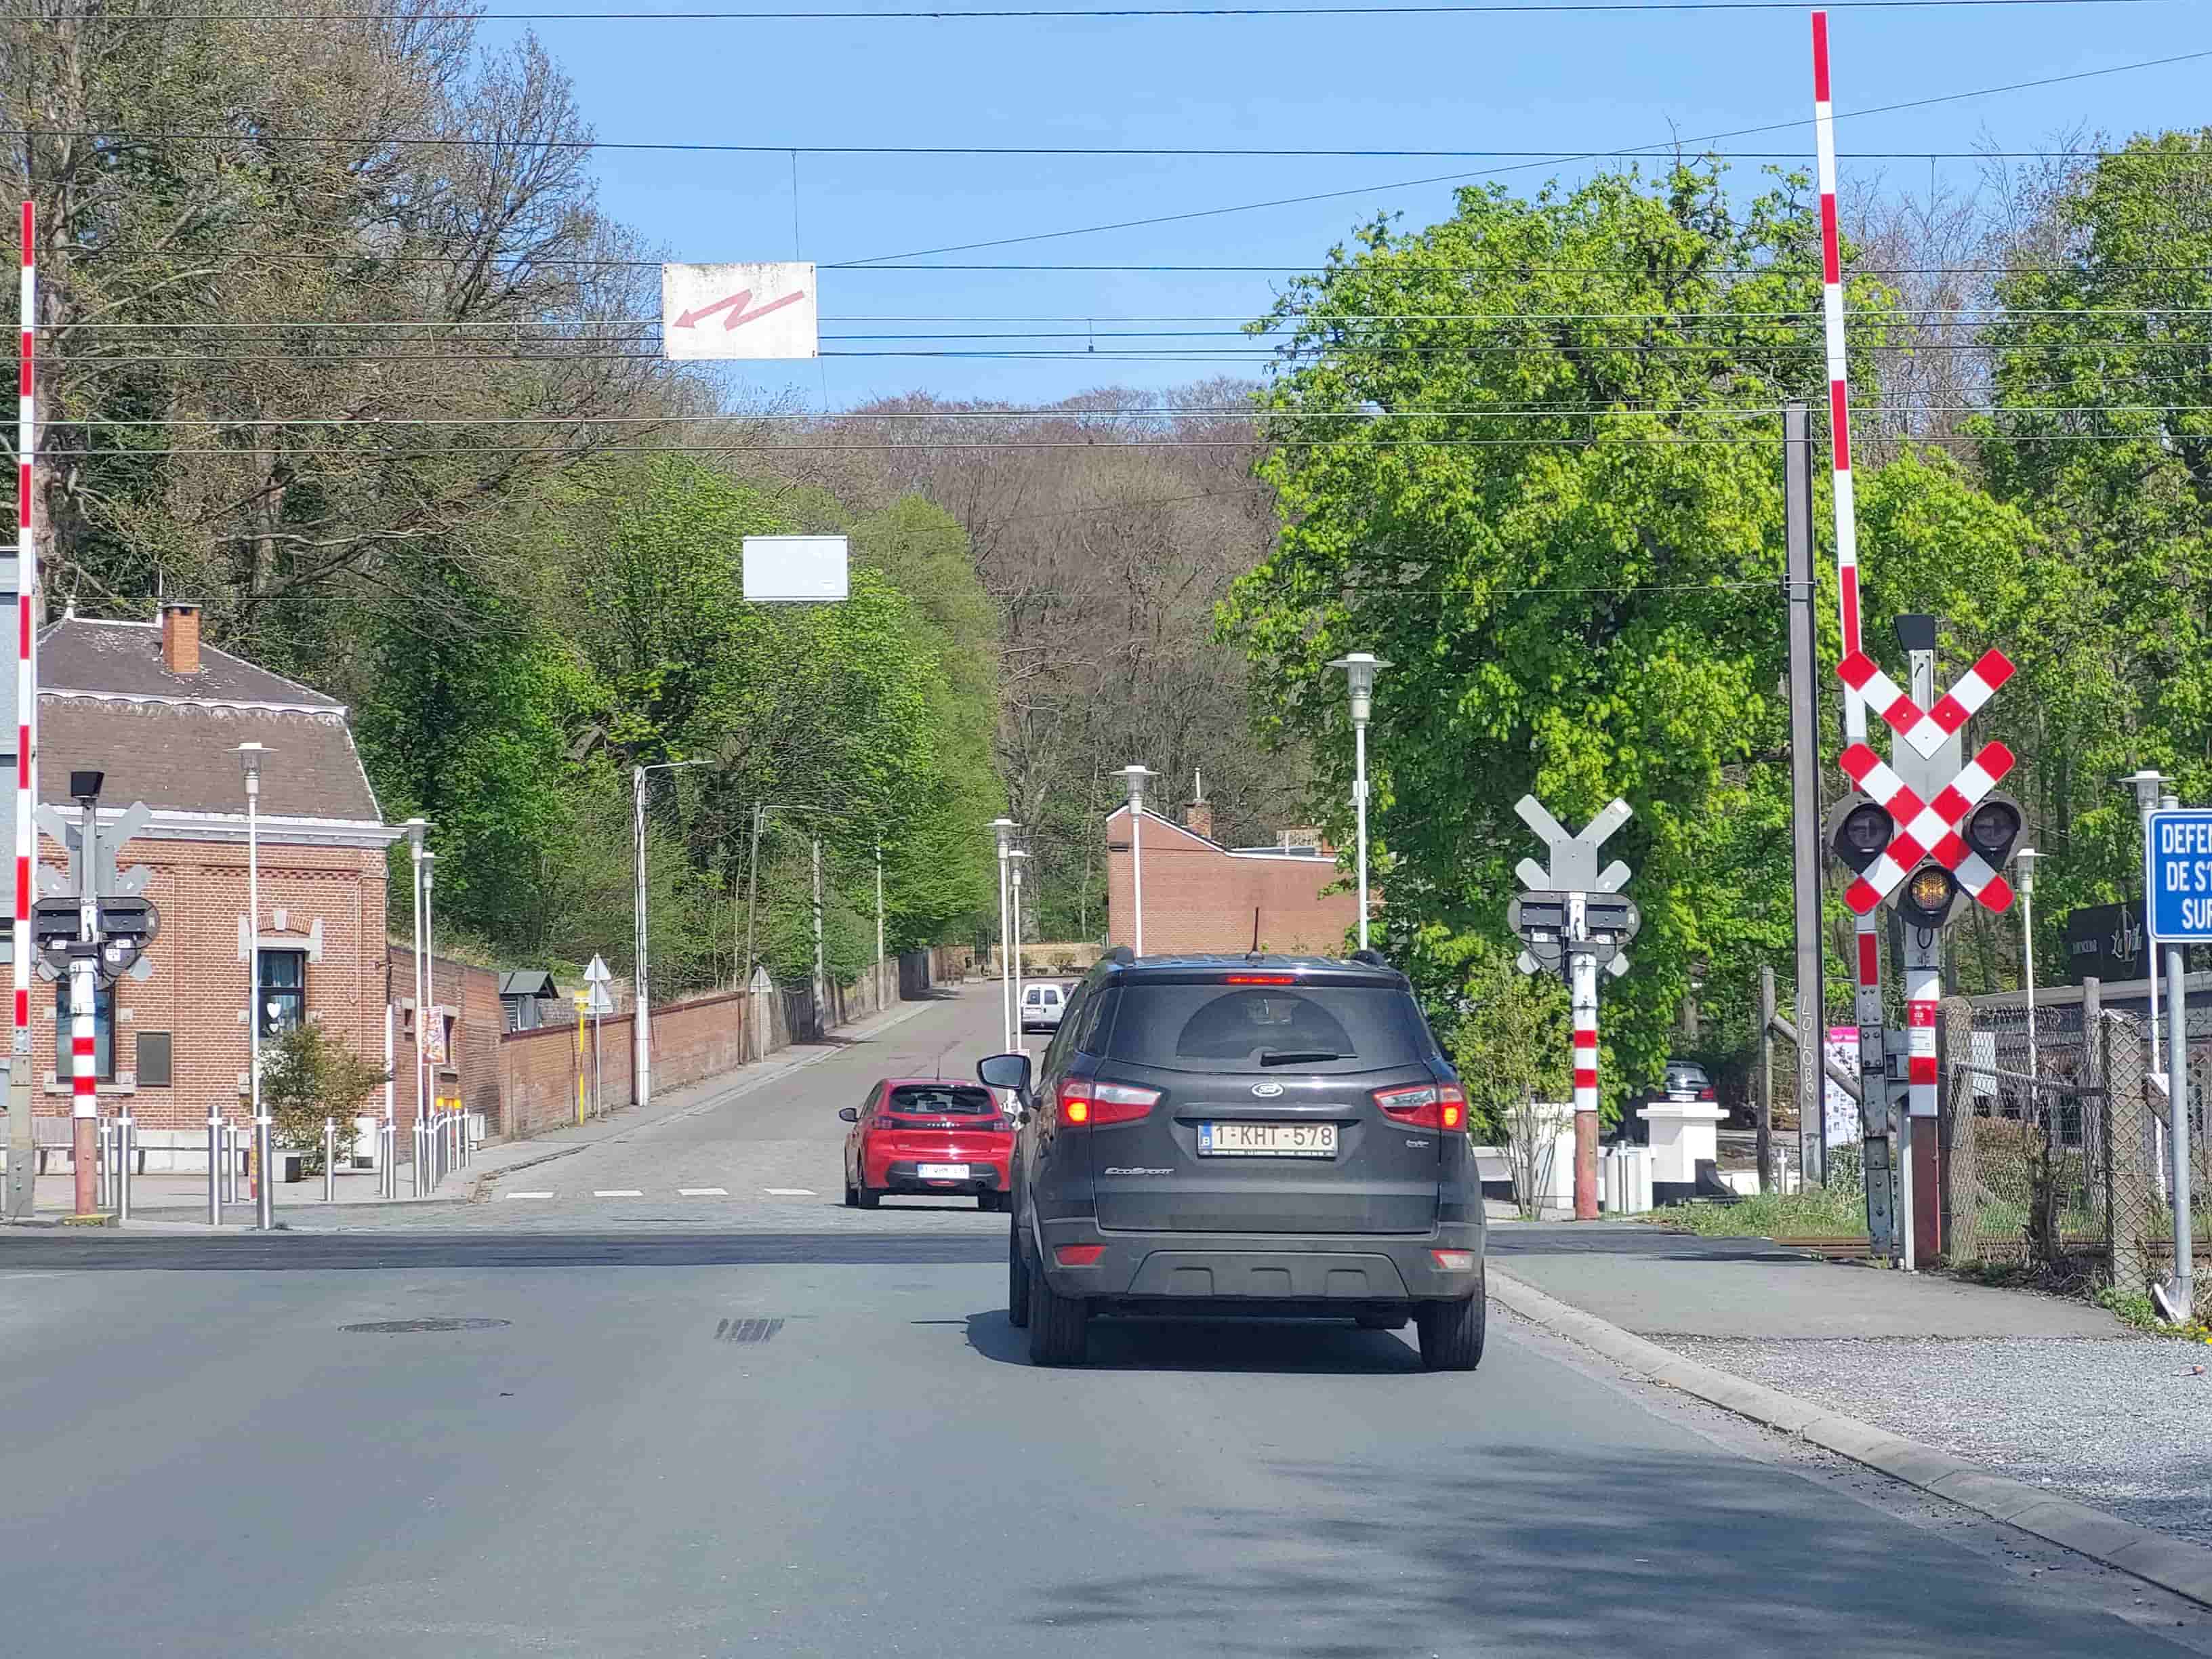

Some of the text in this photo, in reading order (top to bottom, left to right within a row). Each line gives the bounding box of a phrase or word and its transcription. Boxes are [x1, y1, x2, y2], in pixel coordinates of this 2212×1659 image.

[2166, 861, 2212, 891] DE S'
[1216, 1125, 1332, 1146] 1-KHT-578
